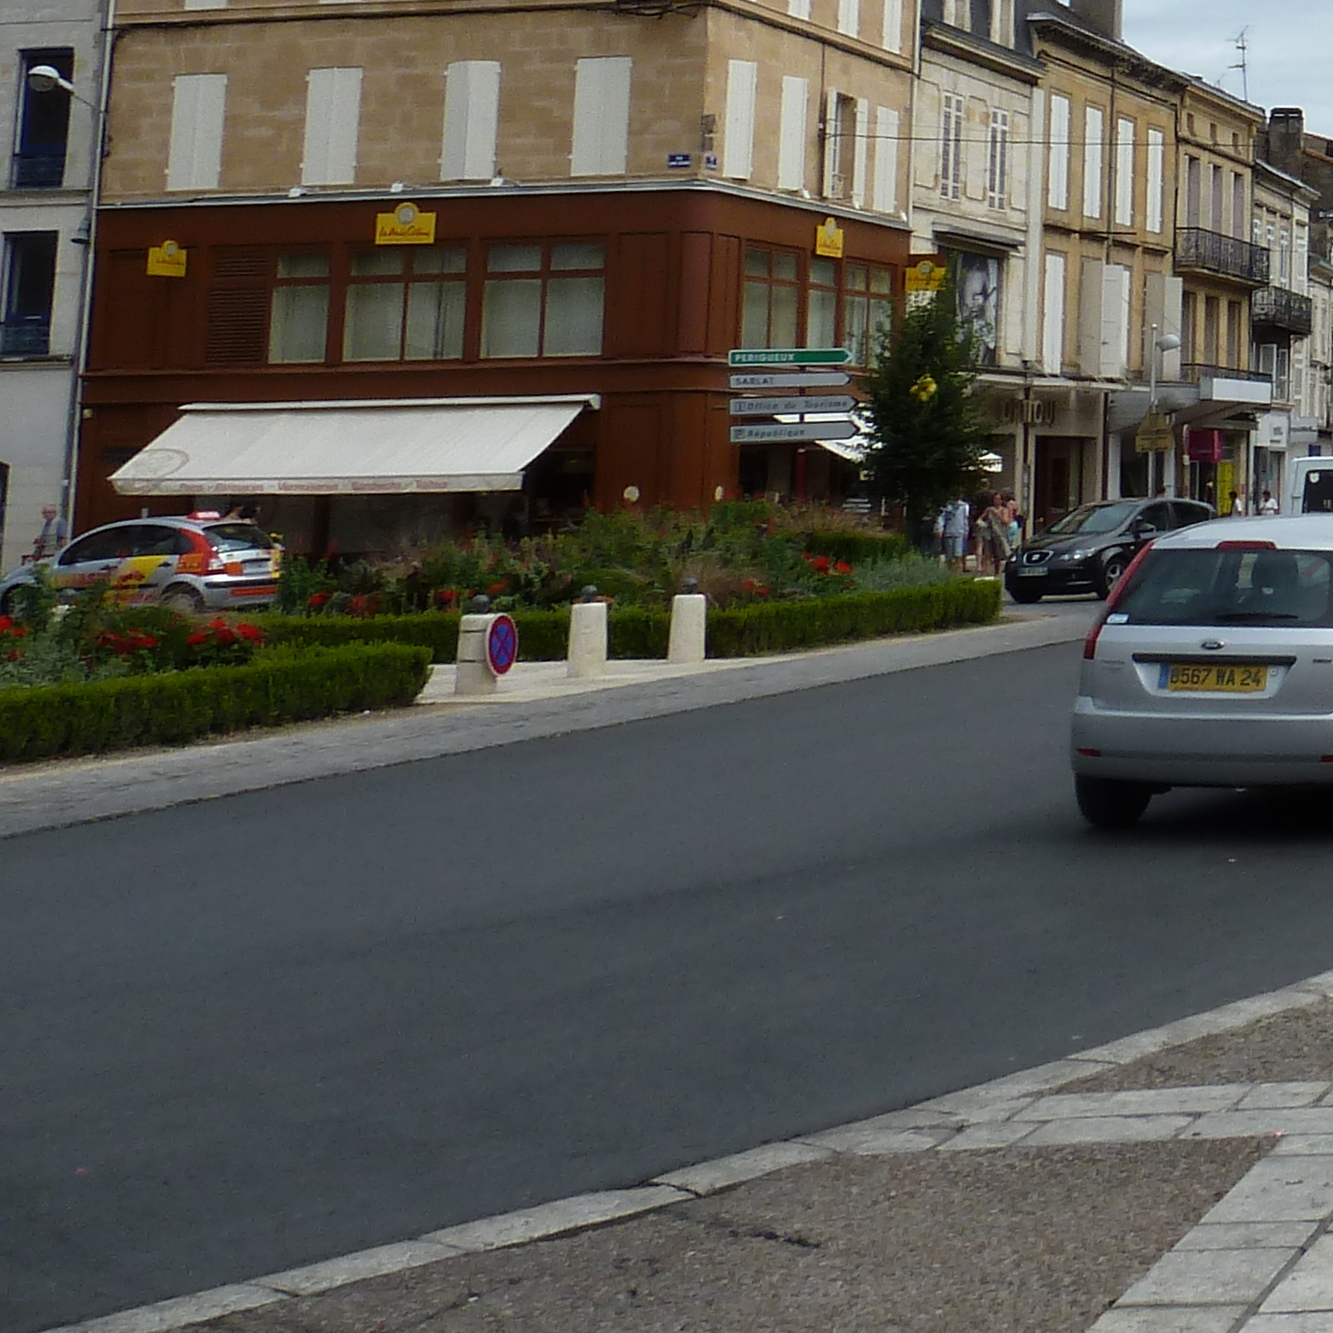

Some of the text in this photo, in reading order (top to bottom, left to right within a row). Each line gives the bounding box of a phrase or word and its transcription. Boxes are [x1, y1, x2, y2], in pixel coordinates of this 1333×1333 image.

[735, 377, 774, 385] SARLAT
[1215, 668, 1236, 686] WA
[1240, 669, 1263, 687] 24
